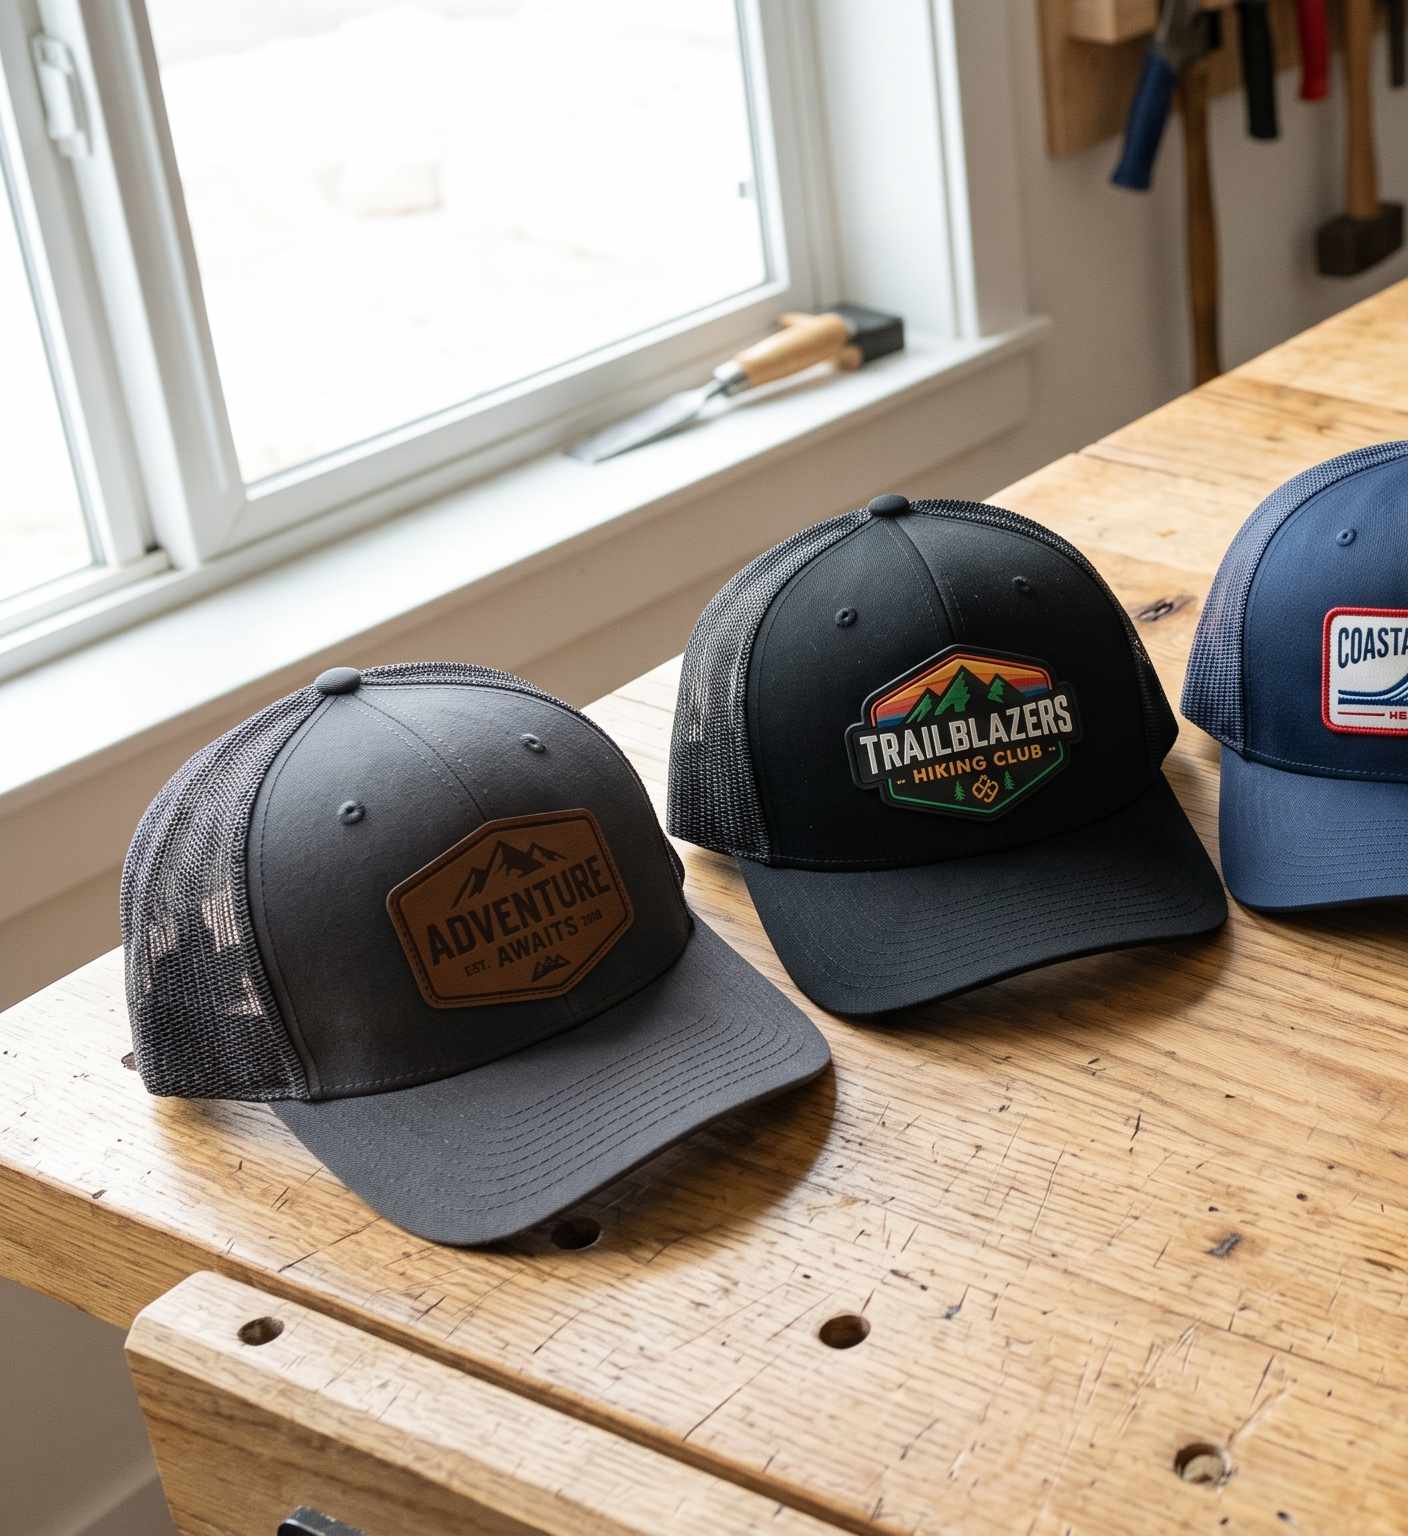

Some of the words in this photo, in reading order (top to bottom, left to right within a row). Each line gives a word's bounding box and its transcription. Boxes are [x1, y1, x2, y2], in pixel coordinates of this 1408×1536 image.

[859, 694, 1073, 775] TRAILBLAZERS
[912, 755, 987, 784] HIKING
[993, 744, 1043, 766] CLUB
[426, 855, 610, 967] ADVENTURE
[464, 963, 491, 977] EST.
[498, 918, 579, 968] AWAITS
